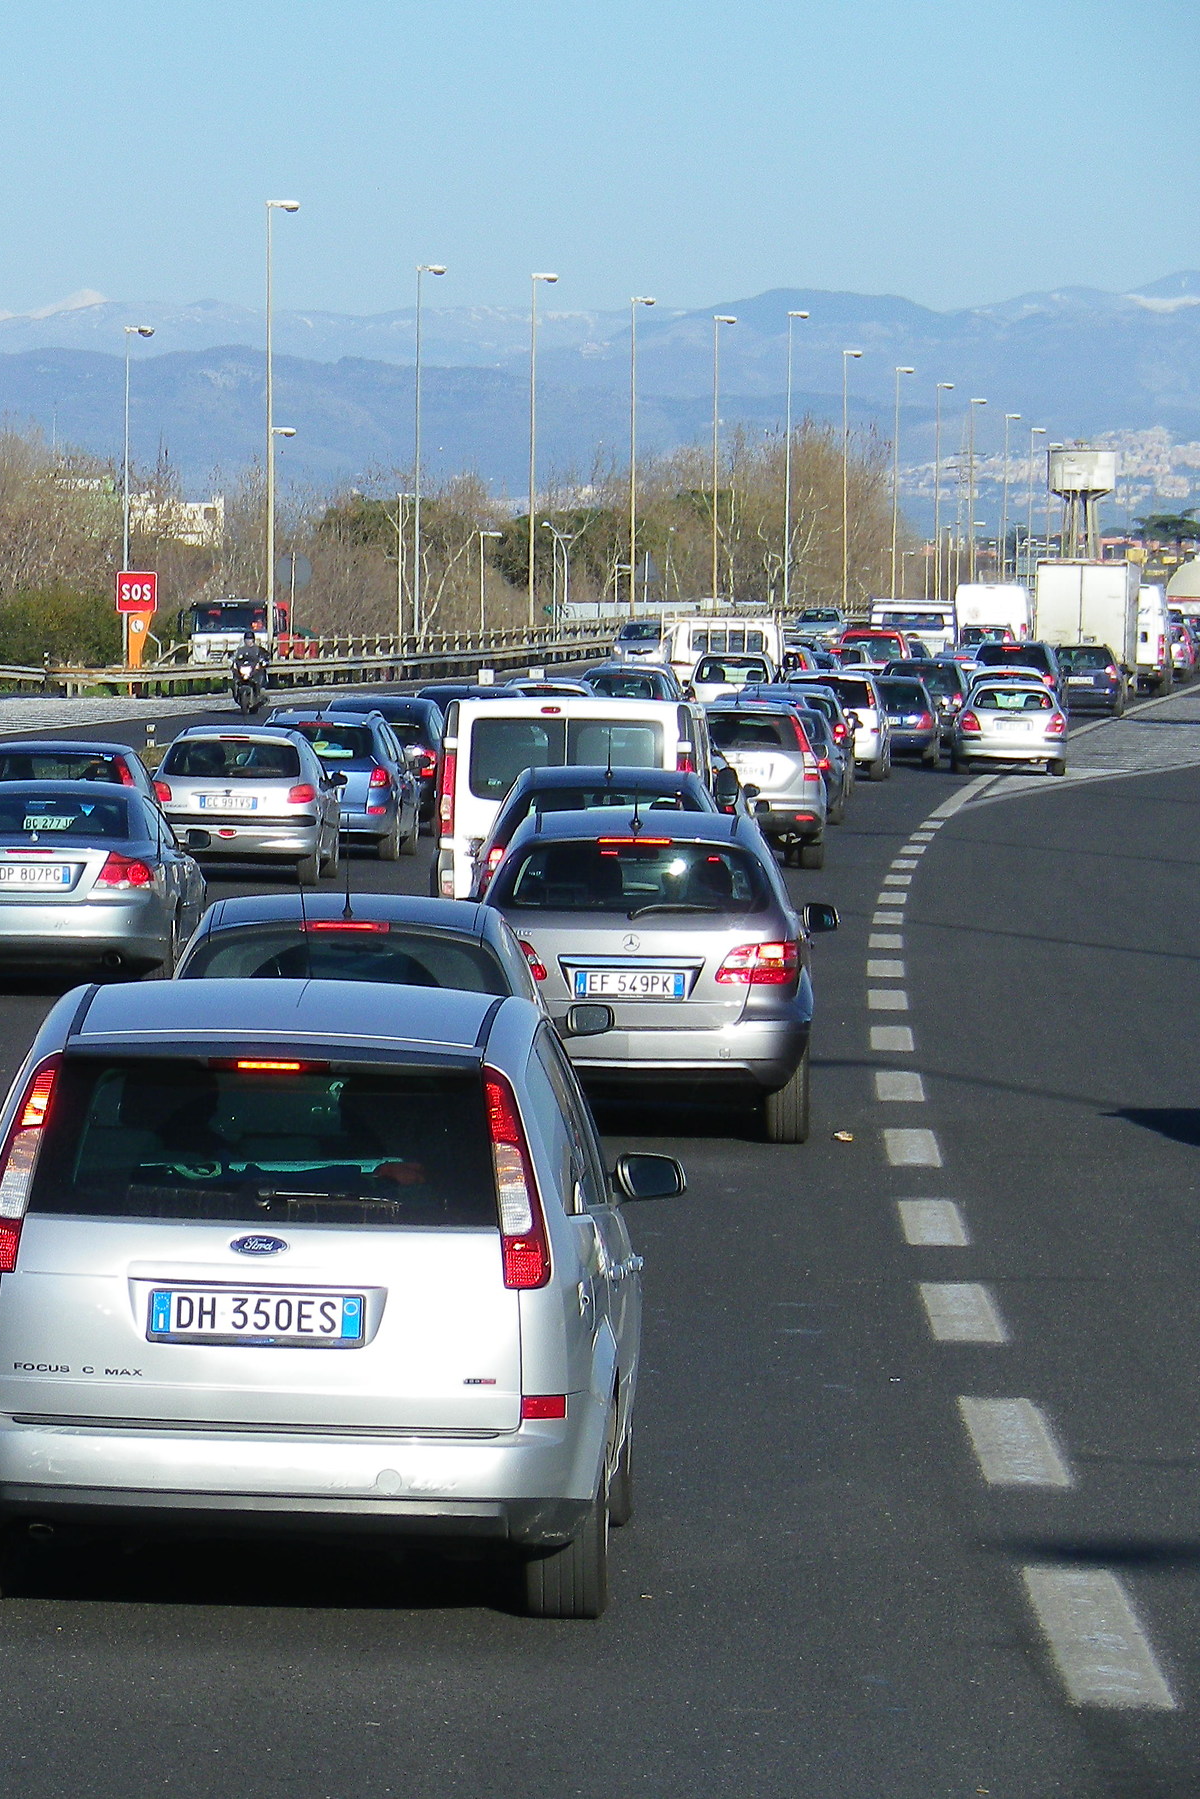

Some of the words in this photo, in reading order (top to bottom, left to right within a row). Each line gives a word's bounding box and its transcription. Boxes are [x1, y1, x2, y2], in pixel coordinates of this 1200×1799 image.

[121, 583, 152, 602] SOS
[206, 797, 218, 807] CC
[25, 818, 38, 829] BC
[0, 867, 14, 880] DP
[589, 974, 610, 991] EF
[617, 975, 671, 993] 549PK
[244, 1237, 275, 1251] Ford
[176, 1296, 216, 1329] DH
[231, 1297, 337, 1334] 350ES
[13, 1362, 70, 1373] FOCUS
[82, 1366, 95, 1374] C
[104, 1368, 143, 1377] MAX
